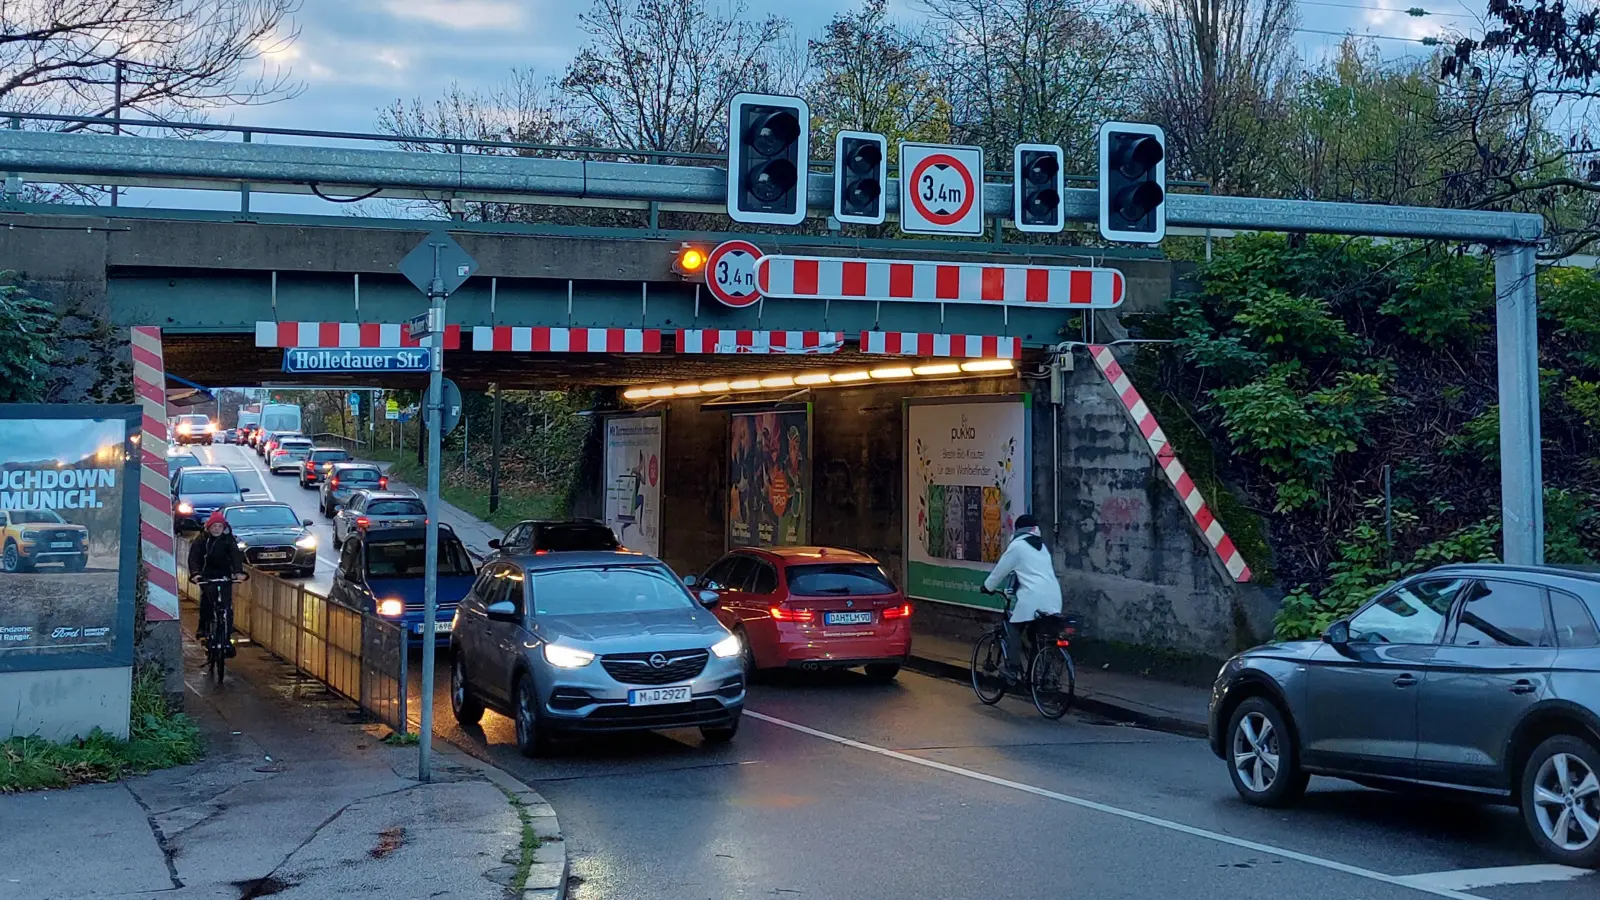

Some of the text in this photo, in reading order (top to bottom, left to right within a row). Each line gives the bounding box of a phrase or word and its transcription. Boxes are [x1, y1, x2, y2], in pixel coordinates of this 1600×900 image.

[296, 351, 424, 369] Holledauer Str.
[0, 490, 103, 510] MUNICH.
[51, 627, 80, 638] Ford
